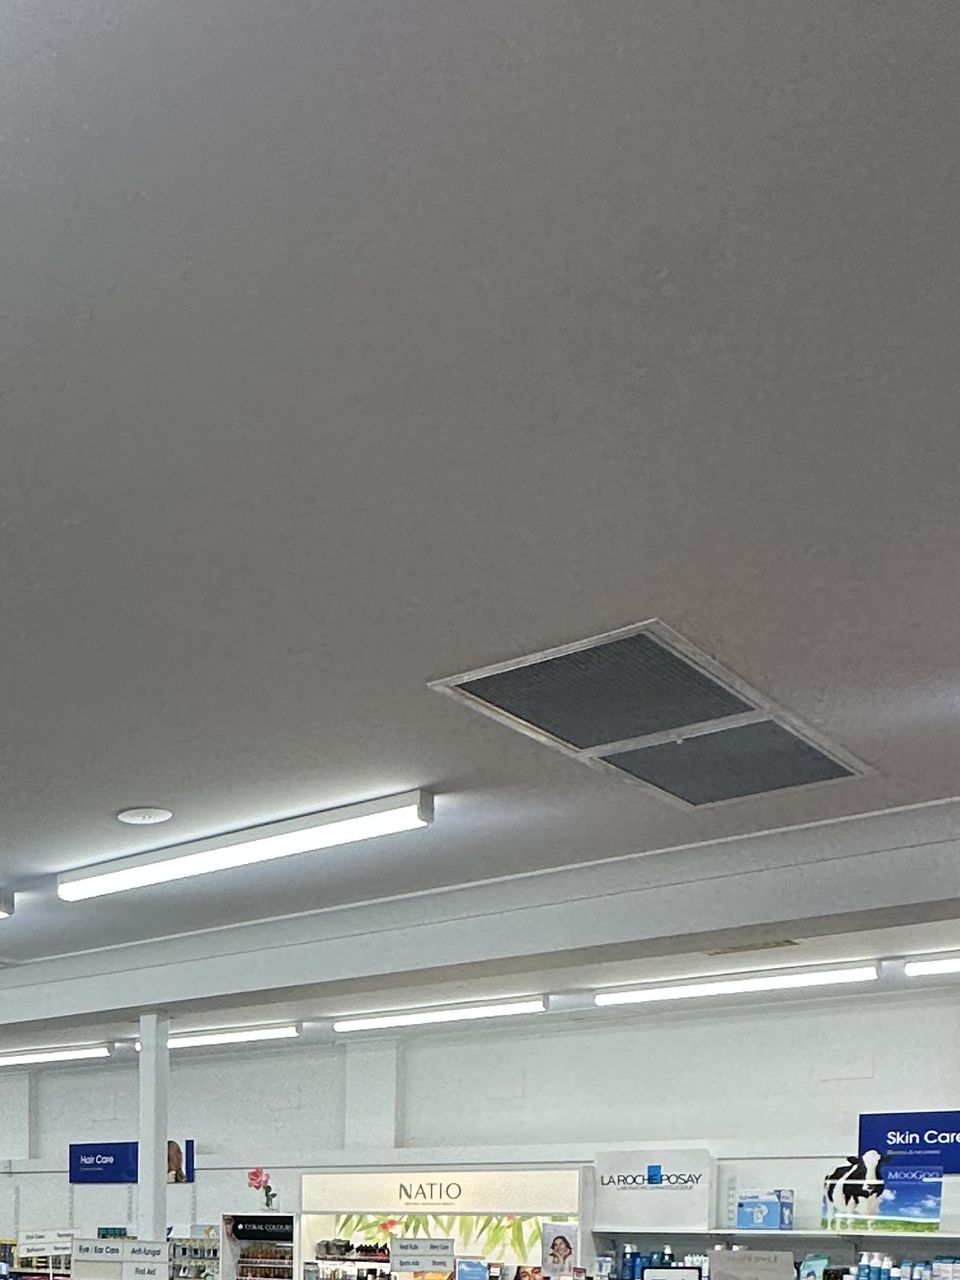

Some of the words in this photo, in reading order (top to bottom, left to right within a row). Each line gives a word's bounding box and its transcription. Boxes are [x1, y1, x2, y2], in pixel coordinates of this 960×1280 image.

[886, 1131, 920, 1145] Skin
[80, 1155, 95, 1165] Hair
[95, 1154, 115, 1165] Care
[600, 1174, 616, 1186] LA
[617, 1174, 661, 1185] ROCHE
[661, 1173, 703, 1185] POSAY
[399, 1182, 462, 1200] NATIO
